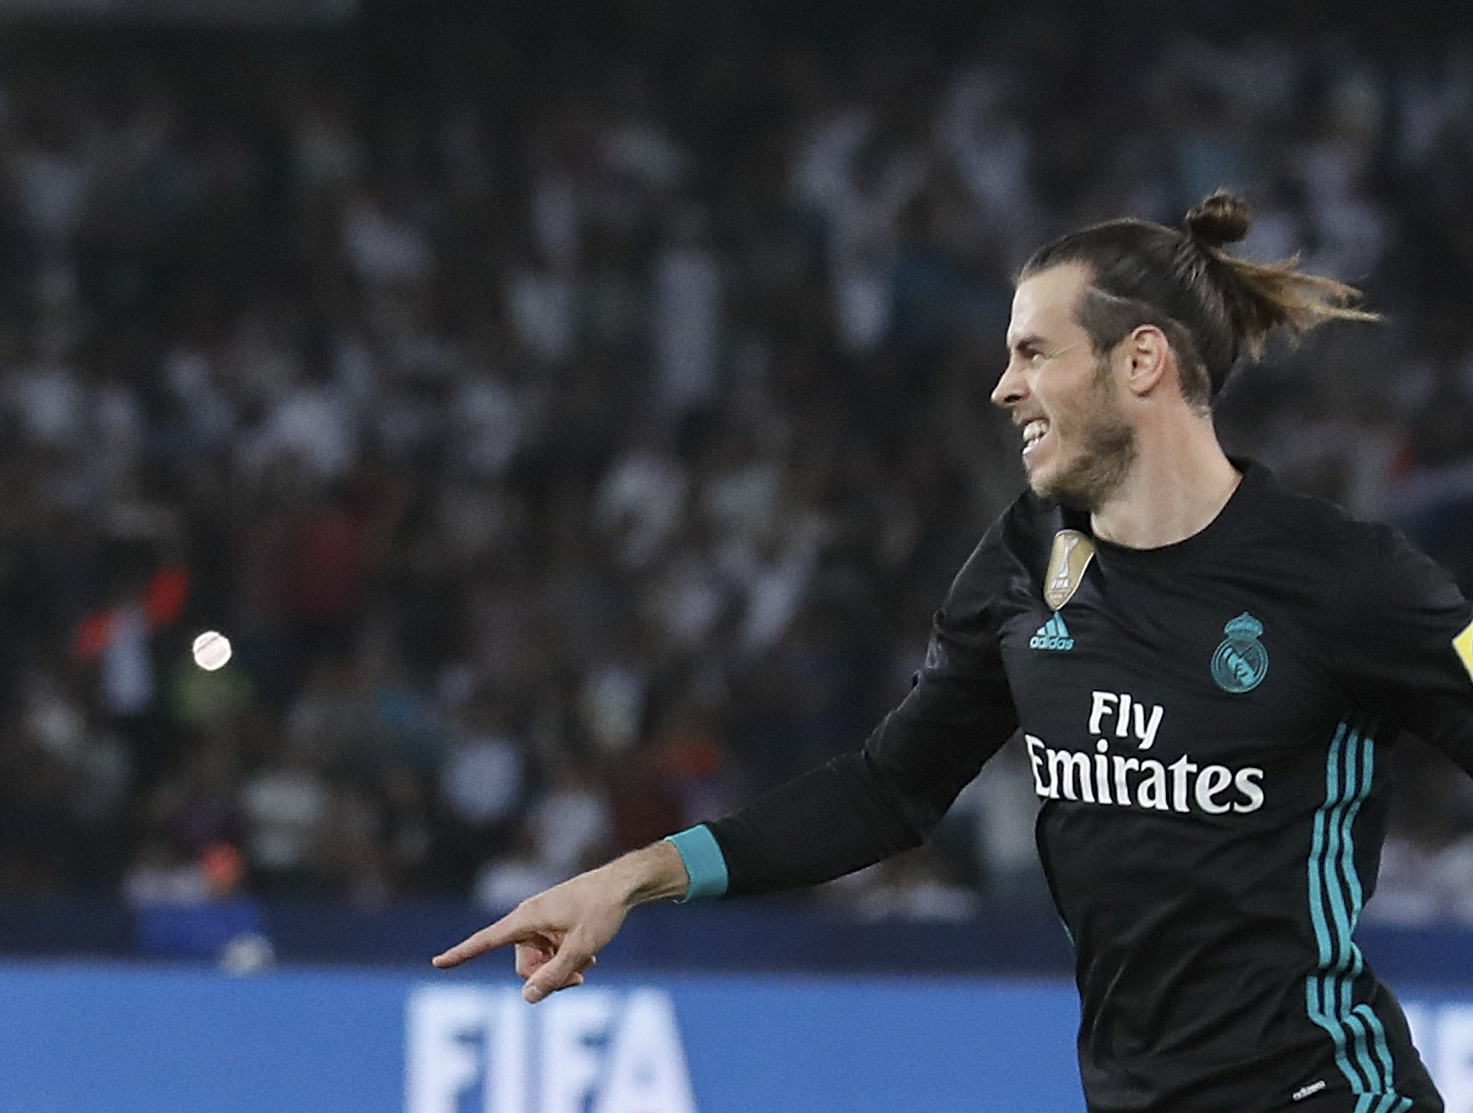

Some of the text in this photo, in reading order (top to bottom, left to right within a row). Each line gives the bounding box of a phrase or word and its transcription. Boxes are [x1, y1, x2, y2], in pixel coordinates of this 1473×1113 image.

[1029, 635, 1075, 651] adidas
[1088, 690, 1164, 750] Fly
[1025, 734, 1265, 814] Emirates
